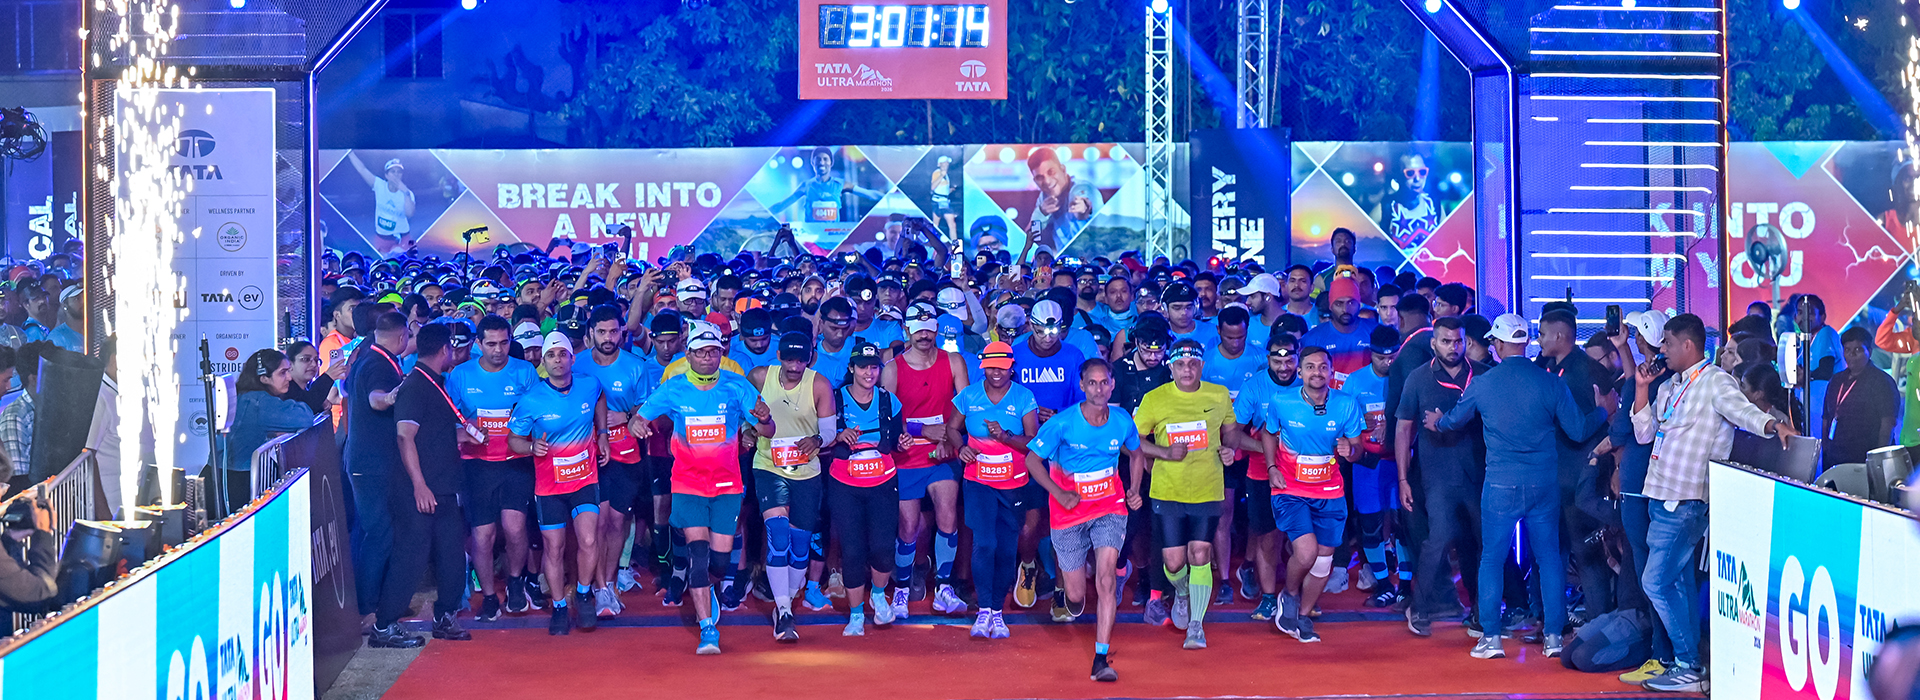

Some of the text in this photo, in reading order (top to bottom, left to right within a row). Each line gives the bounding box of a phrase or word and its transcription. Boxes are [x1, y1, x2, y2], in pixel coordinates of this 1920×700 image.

[848, 6, 989, 48] 3:01:14
[815, 63, 852, 74] TATA
[817, 77, 854, 87] ULTRA
[955, 82, 991, 92] TATA
[497, 182, 722, 209] BREAK INTO
[1211, 166, 1237, 260] VERY
[551, 213, 577, 239] A
[201, 293, 234, 302] TATA
[211, 363, 241, 373] STRIDE
[482, 420, 508, 429] 35984
[692, 428, 719, 437] 36755
[1173, 434, 1202, 444] 36854
[560, 464, 585, 476] 36441
[853, 462, 879, 471] 38131
[980, 466, 1008, 474] 38283
[1302, 467, 1327, 475] 35071
[1082, 481, 1109, 494] 35779
[1716, 550, 1737, 585] TATA
[1718, 590, 1739, 622] ULTRA
[1779, 554, 1841, 700] GO
[1860, 604, 1887, 643] TATA
[258, 571, 285, 700] GO
